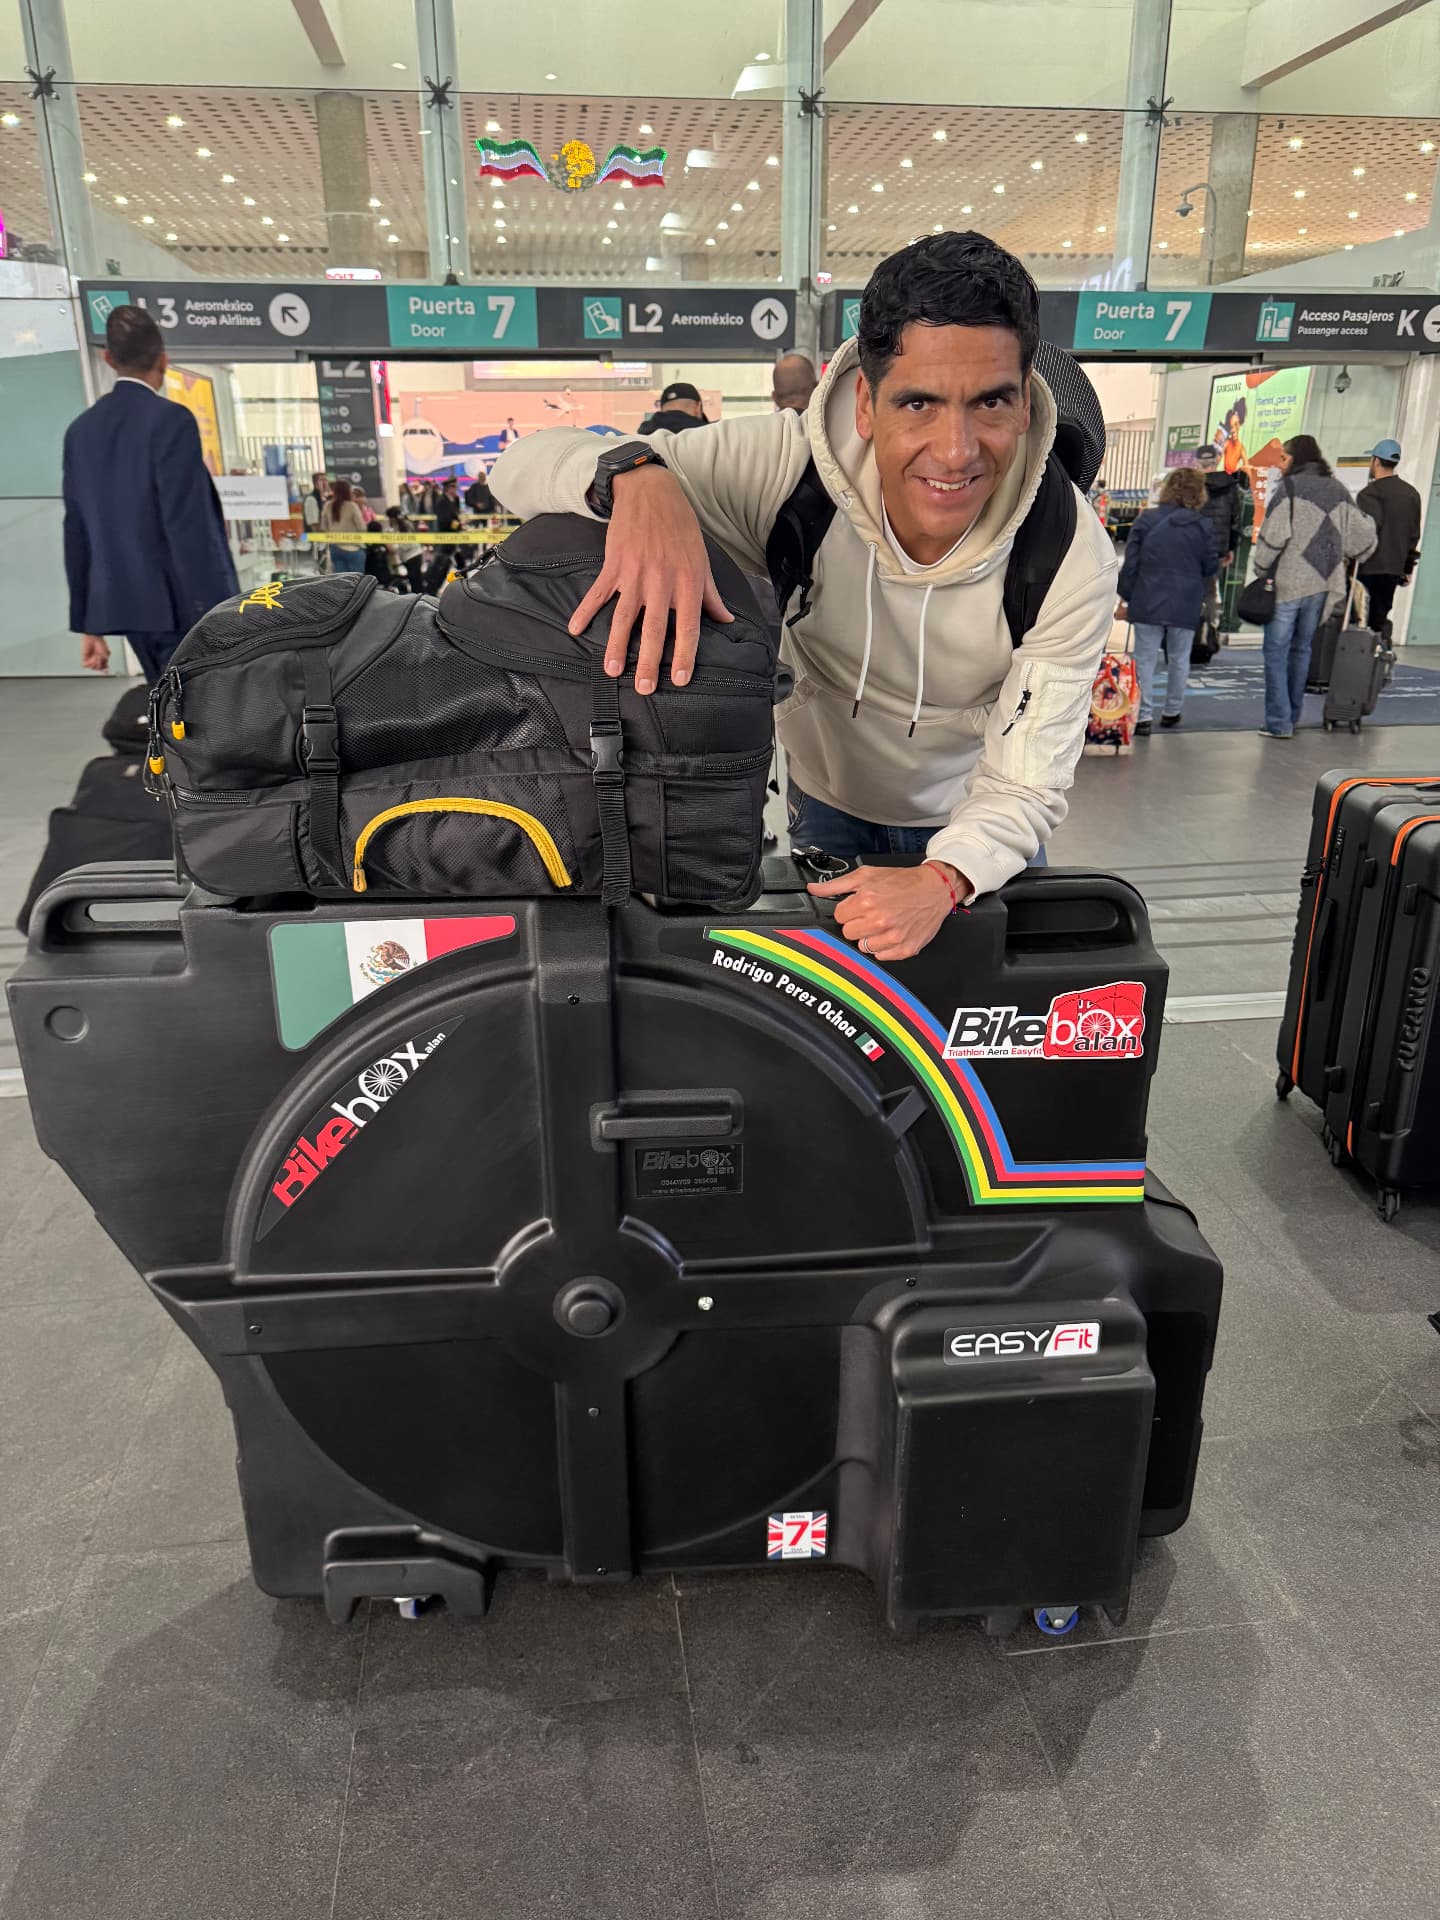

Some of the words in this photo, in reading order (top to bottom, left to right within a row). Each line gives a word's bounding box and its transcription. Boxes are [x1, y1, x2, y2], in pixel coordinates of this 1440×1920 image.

[184, 299, 255, 313] Aeroméxico
[186, 313, 218, 328] Copa
[218, 312, 263, 327] Airlines
[408, 296, 476, 316] Puerta
[487, 295, 516, 339] 7
[628, 302, 664, 333] L2
[671, 312, 745, 326] Aeroméxico
[1095, 302, 1156, 319] Puerta
[1164, 300, 1193, 342] 7
[1299, 309, 1341, 322] Acceso
[1342, 309, 1396, 325] Pasajeros
[1396, 309, 1420, 337] K
[410, 323, 446, 337] Door
[1093, 327, 1126, 340] Door
[1297, 325, 1340, 336] Passenger
[1340, 326, 1369, 336] access
[712, 949, 774, 983] Rodrigo
[775, 974, 818, 1008] Perez
[817, 1000, 857, 1038] Ochoa
[424, 1032, 446, 1055] alan
[1074, 1031, 1137, 1052] alan
[948, 1049, 985, 1057] Triathlon
[987, 1048, 1009, 1056] Aero
[1011, 1047, 1043, 1057] Easyfit
[785, 1521, 810, 1547] 7
